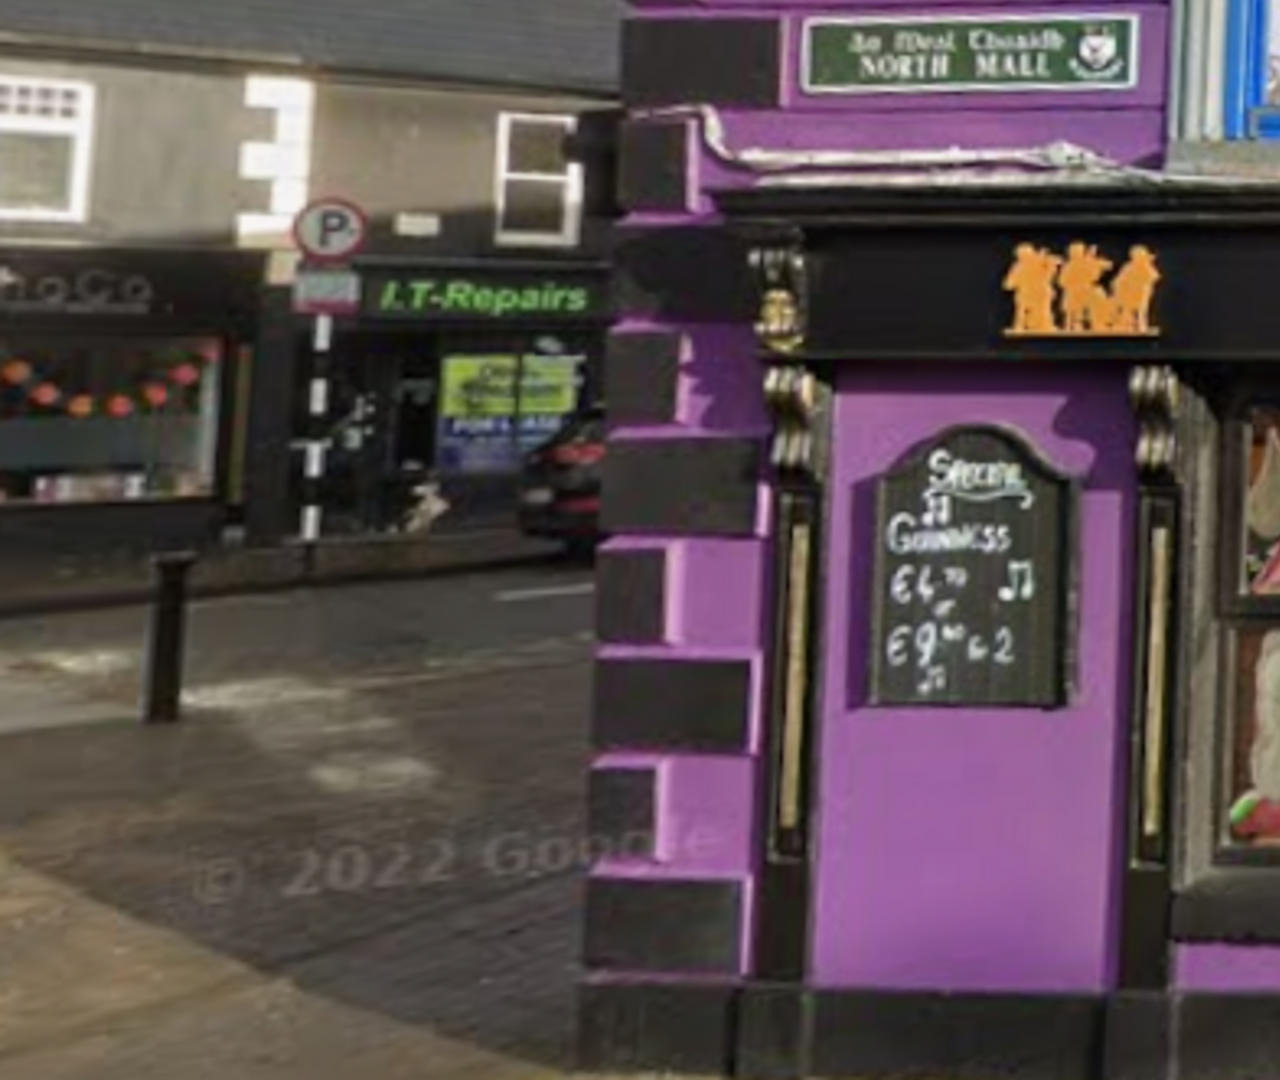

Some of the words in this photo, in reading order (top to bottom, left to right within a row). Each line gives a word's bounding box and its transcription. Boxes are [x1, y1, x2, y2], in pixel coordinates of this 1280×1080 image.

[859, 54, 951, 80] NORTH
[974, 53, 1051, 79] MALL
[320, 212, 346, 248] P
